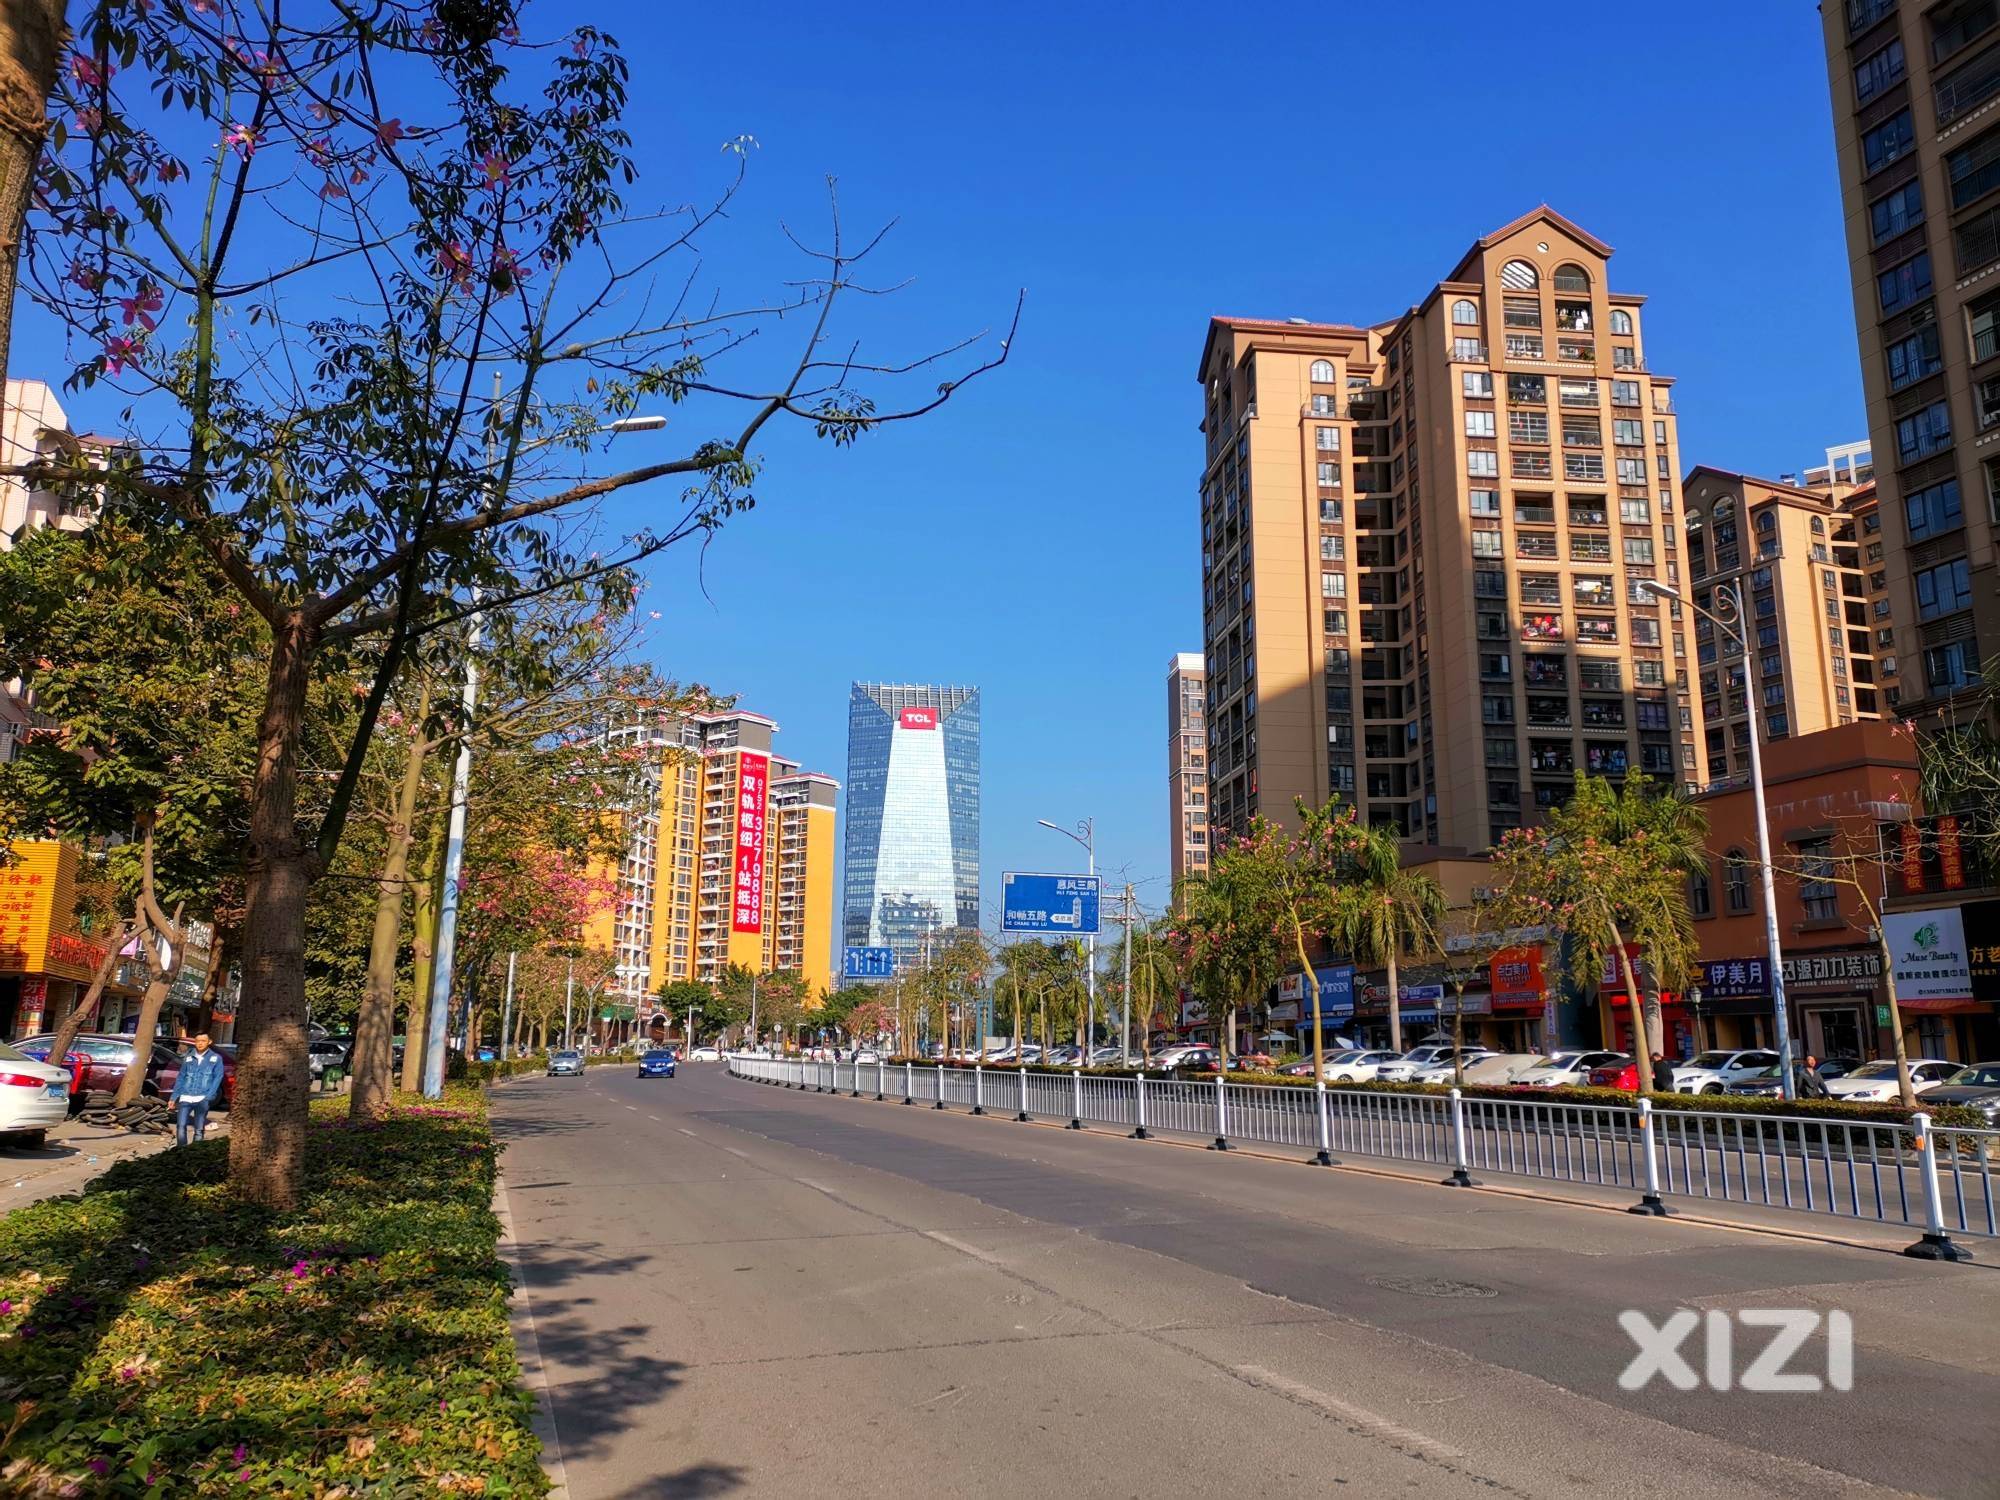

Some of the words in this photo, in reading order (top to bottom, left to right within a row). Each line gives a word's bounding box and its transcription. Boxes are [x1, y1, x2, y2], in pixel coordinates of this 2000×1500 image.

[905, 713, 932, 723] TCL
[740, 775, 755, 847] 双轨枢纽
[751, 778, 763, 925] 0752-3279888
[736, 855, 751, 925] 1站抵深
[1006, 909, 1047, 921] 和畅五路
[1797, 955, 1880, 980] 源动力装饰
[1901, 952, 1928, 963] Muse
[1929, 951, 1958, 962] Beauty
[1711, 962, 1763, 985] 伊美月
[23, 980, 41, 1009] 牙科
